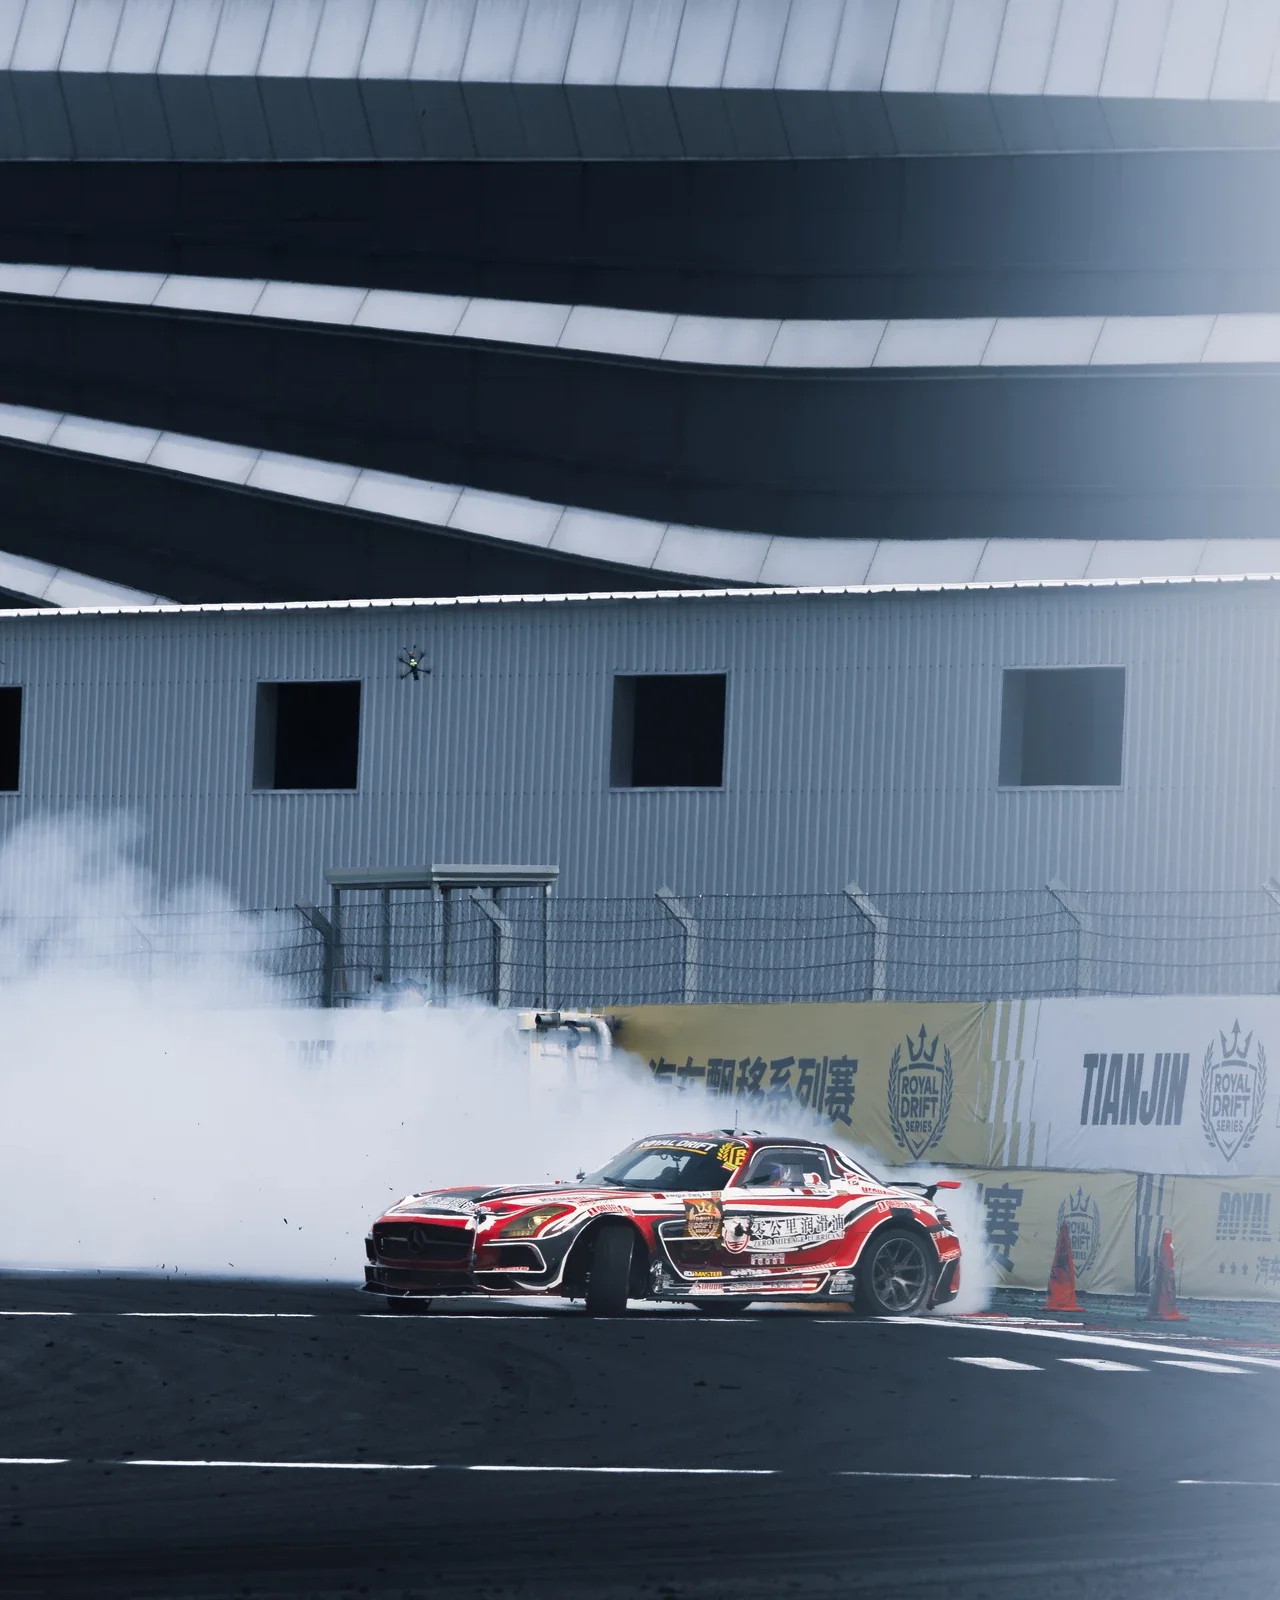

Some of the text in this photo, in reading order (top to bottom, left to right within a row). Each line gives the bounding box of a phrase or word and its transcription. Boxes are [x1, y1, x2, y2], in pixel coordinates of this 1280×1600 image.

[901, 1075, 939, 1095] ROYAL
[1080, 1053, 1190, 1126] TIANJIN
[1214, 1073, 1252, 1093] ROYAL
[900, 1096, 939, 1118] DRIFT
[1212, 1094, 1251, 1117] DRIFT
[905, 1120, 932, 1133] SERIES
[1216, 1119, 1244, 1133] SERIES
[637, 1139, 718, 1152] ROYAL DRIFT
[753, 1238, 772, 1248] ZERO
[774, 1234, 805, 1246] MILEAGE
[1071, 1235, 1091, 1250] RIFT
[1071, 1250, 1088, 1260] ERIES
